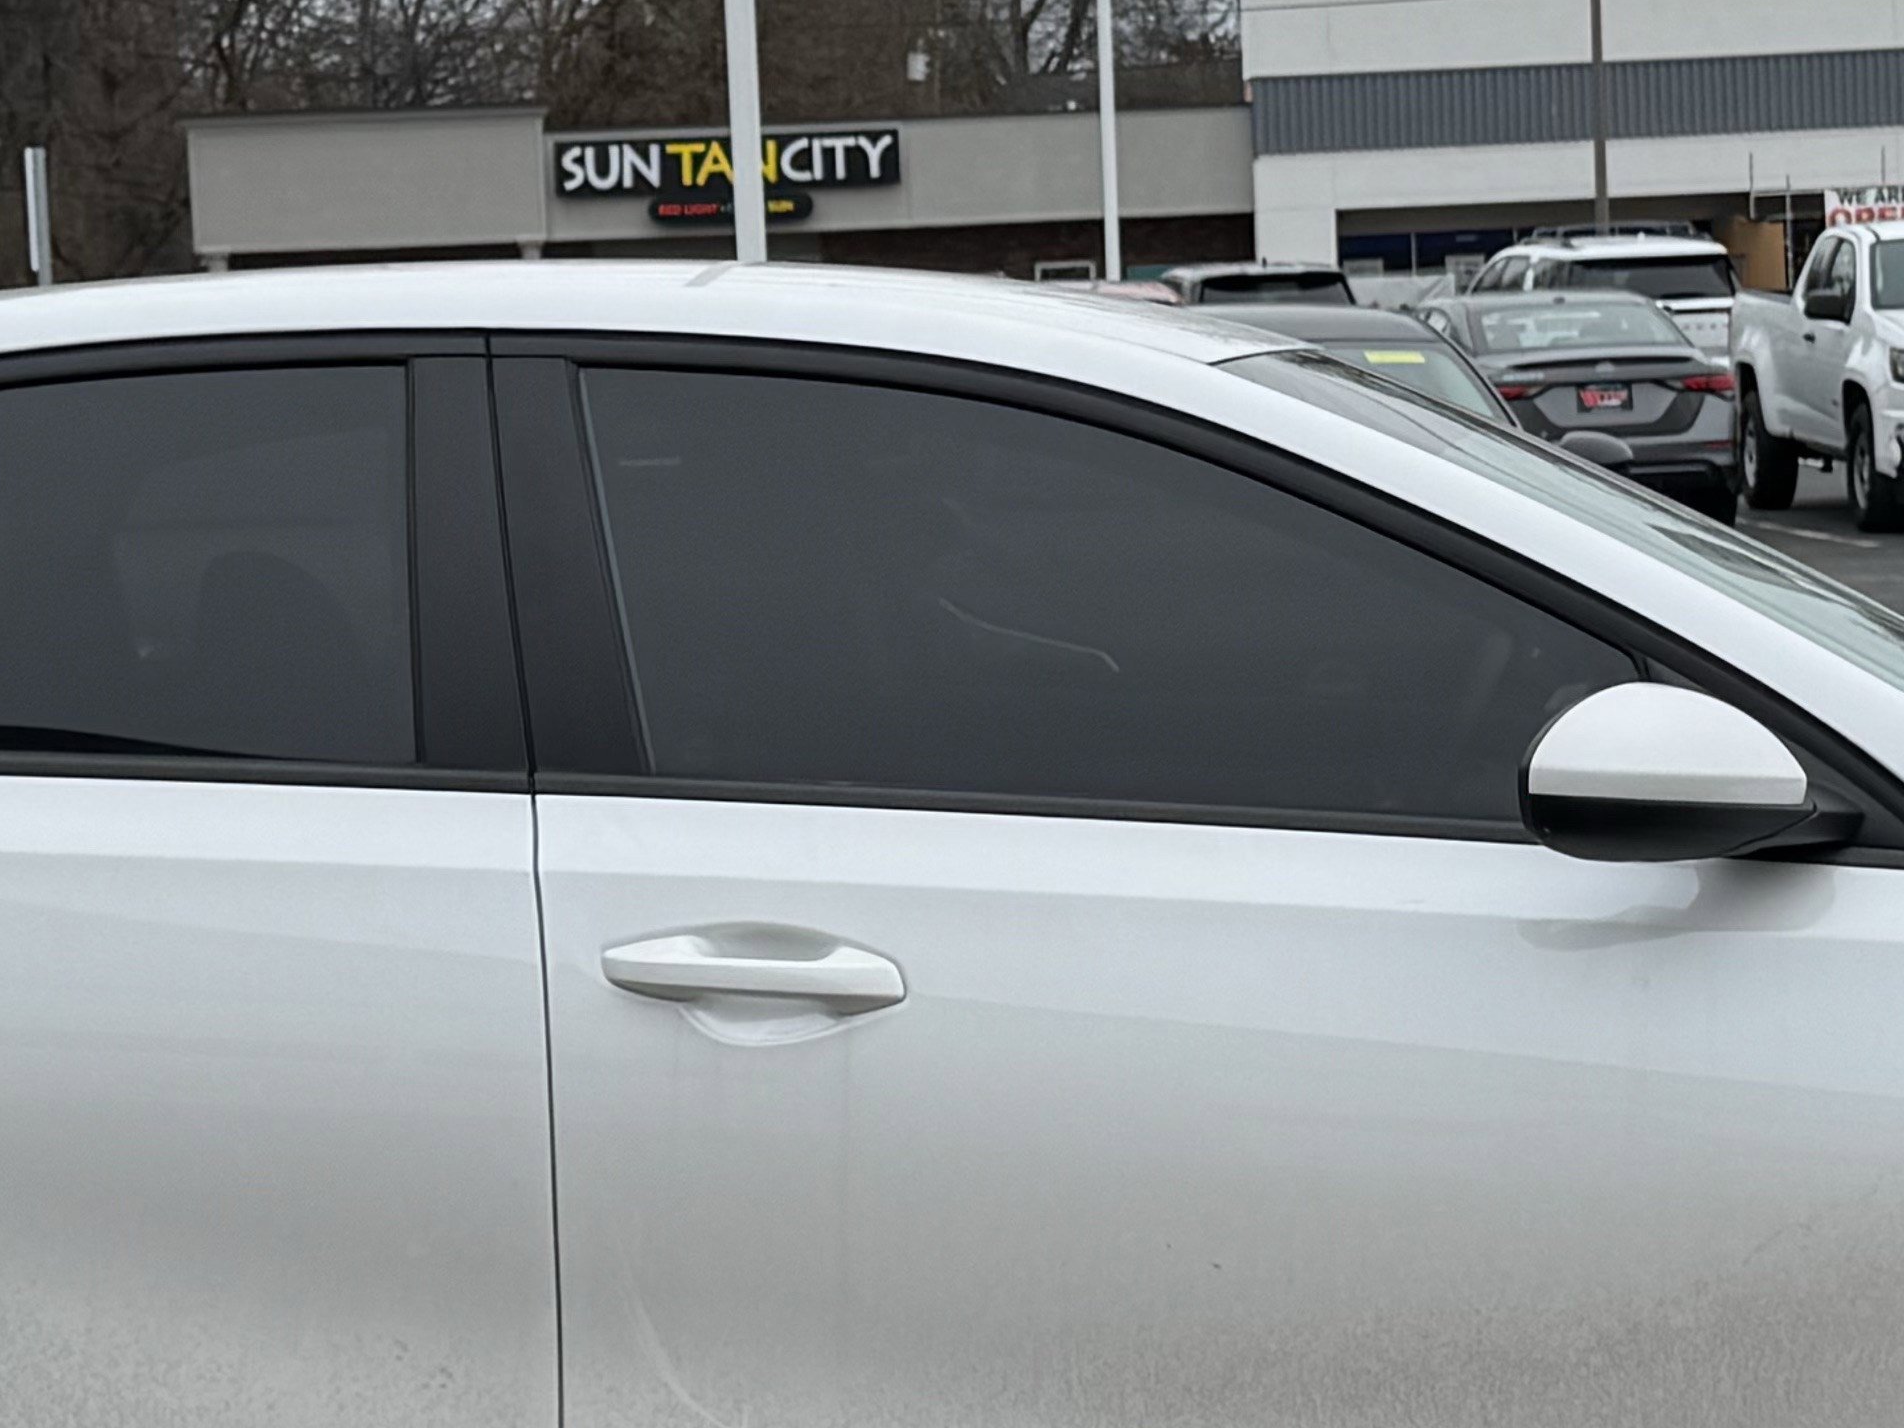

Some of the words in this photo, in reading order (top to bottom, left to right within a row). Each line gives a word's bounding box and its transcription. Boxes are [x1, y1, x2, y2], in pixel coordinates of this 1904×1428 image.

[560, 143, 661, 192] SUN
[780, 134, 893, 182] CITY
[1834, 188, 1868, 206] WE
